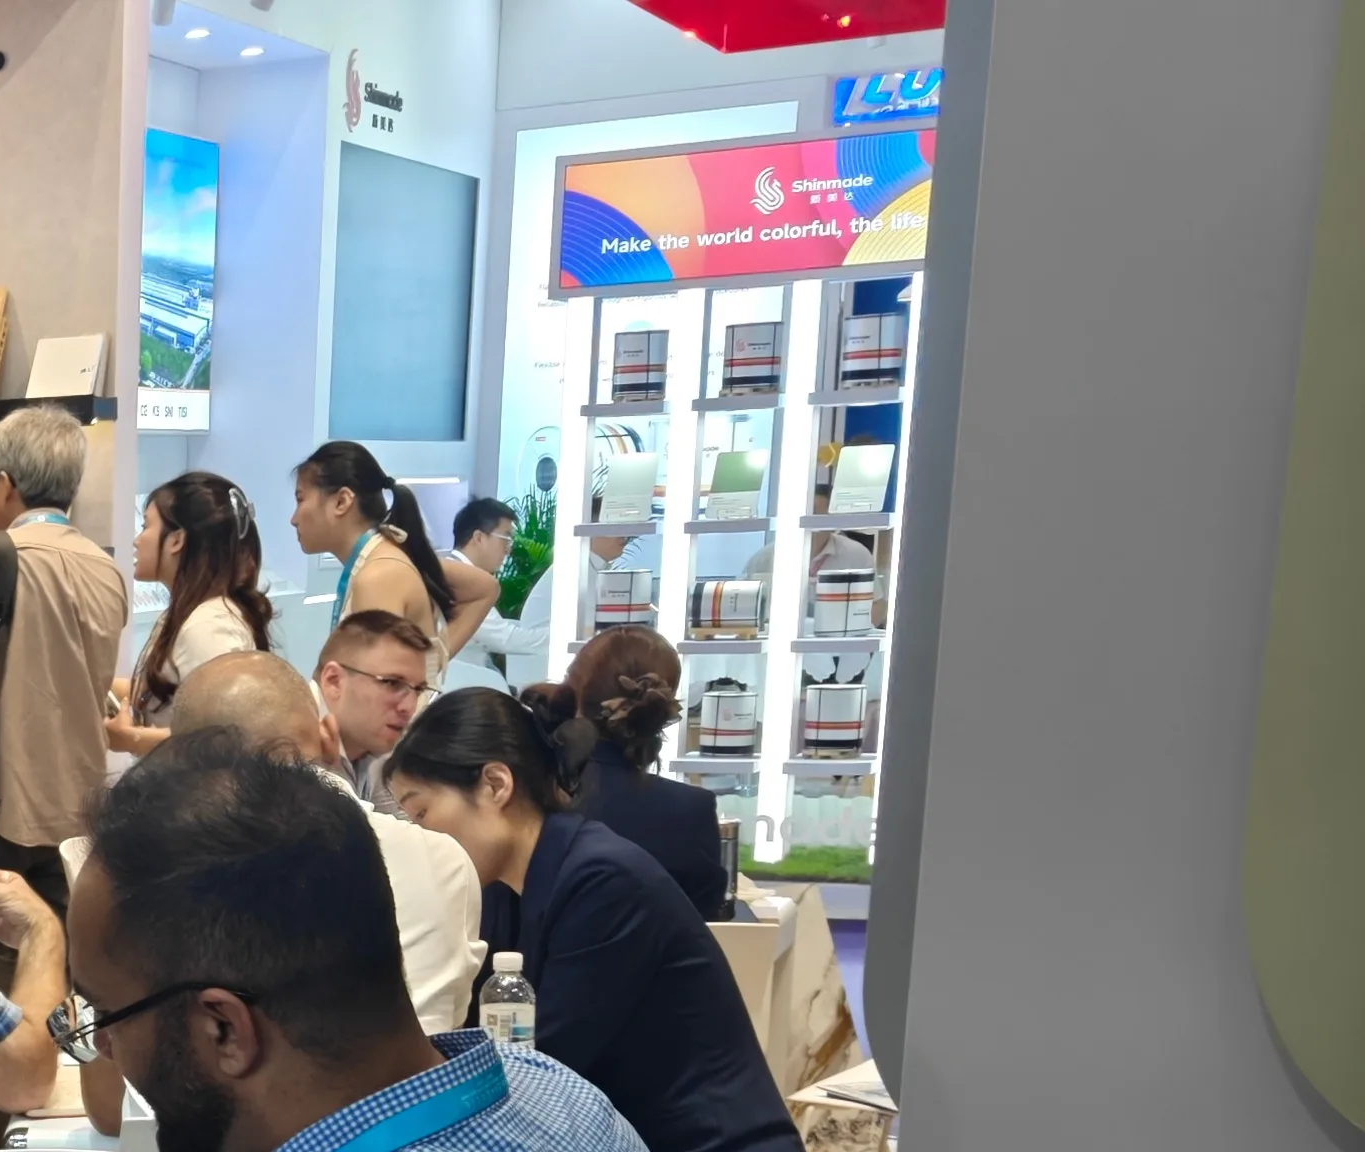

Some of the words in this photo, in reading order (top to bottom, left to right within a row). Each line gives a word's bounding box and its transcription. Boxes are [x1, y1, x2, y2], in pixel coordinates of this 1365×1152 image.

[791, 174, 874, 193] Shinmade
[601, 237, 652, 255] Make
[658, 232, 690, 251] the
[696, 226, 753, 247] world
[759, 219, 842, 243] colorful,
[849, 214, 883, 234] the
[890, 211, 926, 230] life
